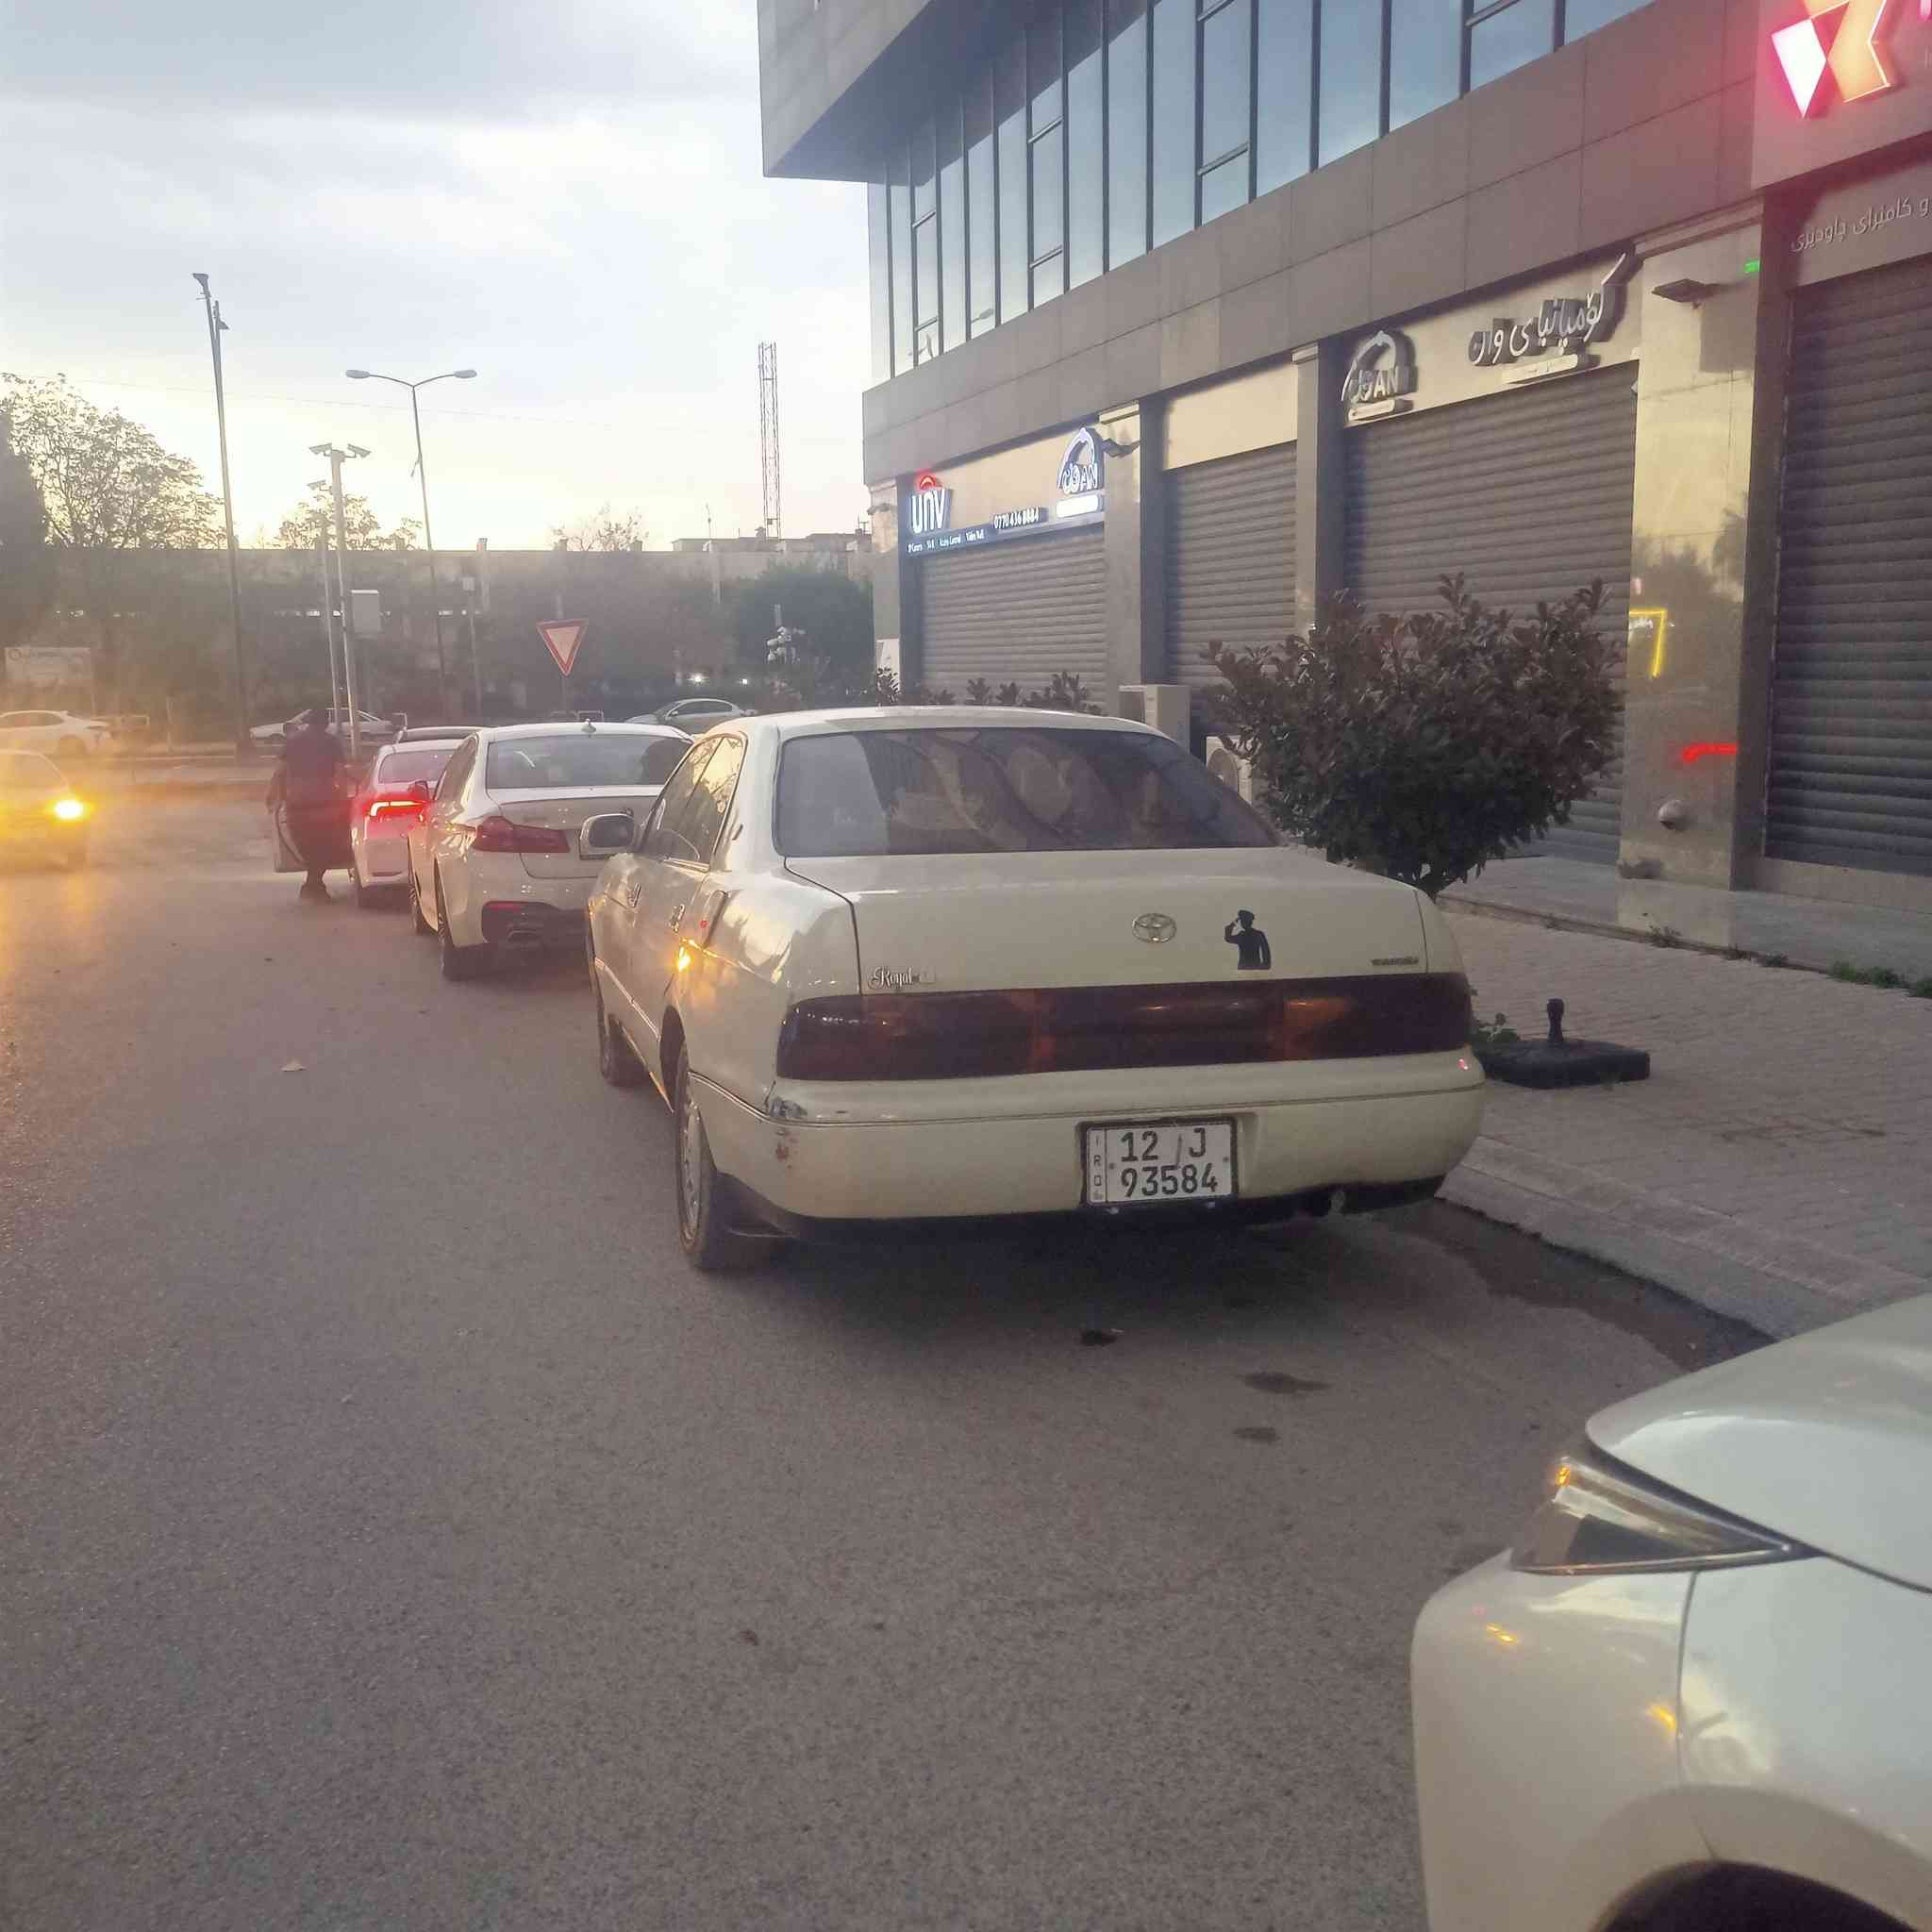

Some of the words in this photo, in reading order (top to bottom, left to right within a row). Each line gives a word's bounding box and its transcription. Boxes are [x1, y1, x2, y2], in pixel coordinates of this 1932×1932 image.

[868, 966, 913, 990] Royal
[1121, 1130, 1159, 1162] 12
[1189, 1127, 1207, 1158] J
[1120, 1162, 1219, 1197] 93584
